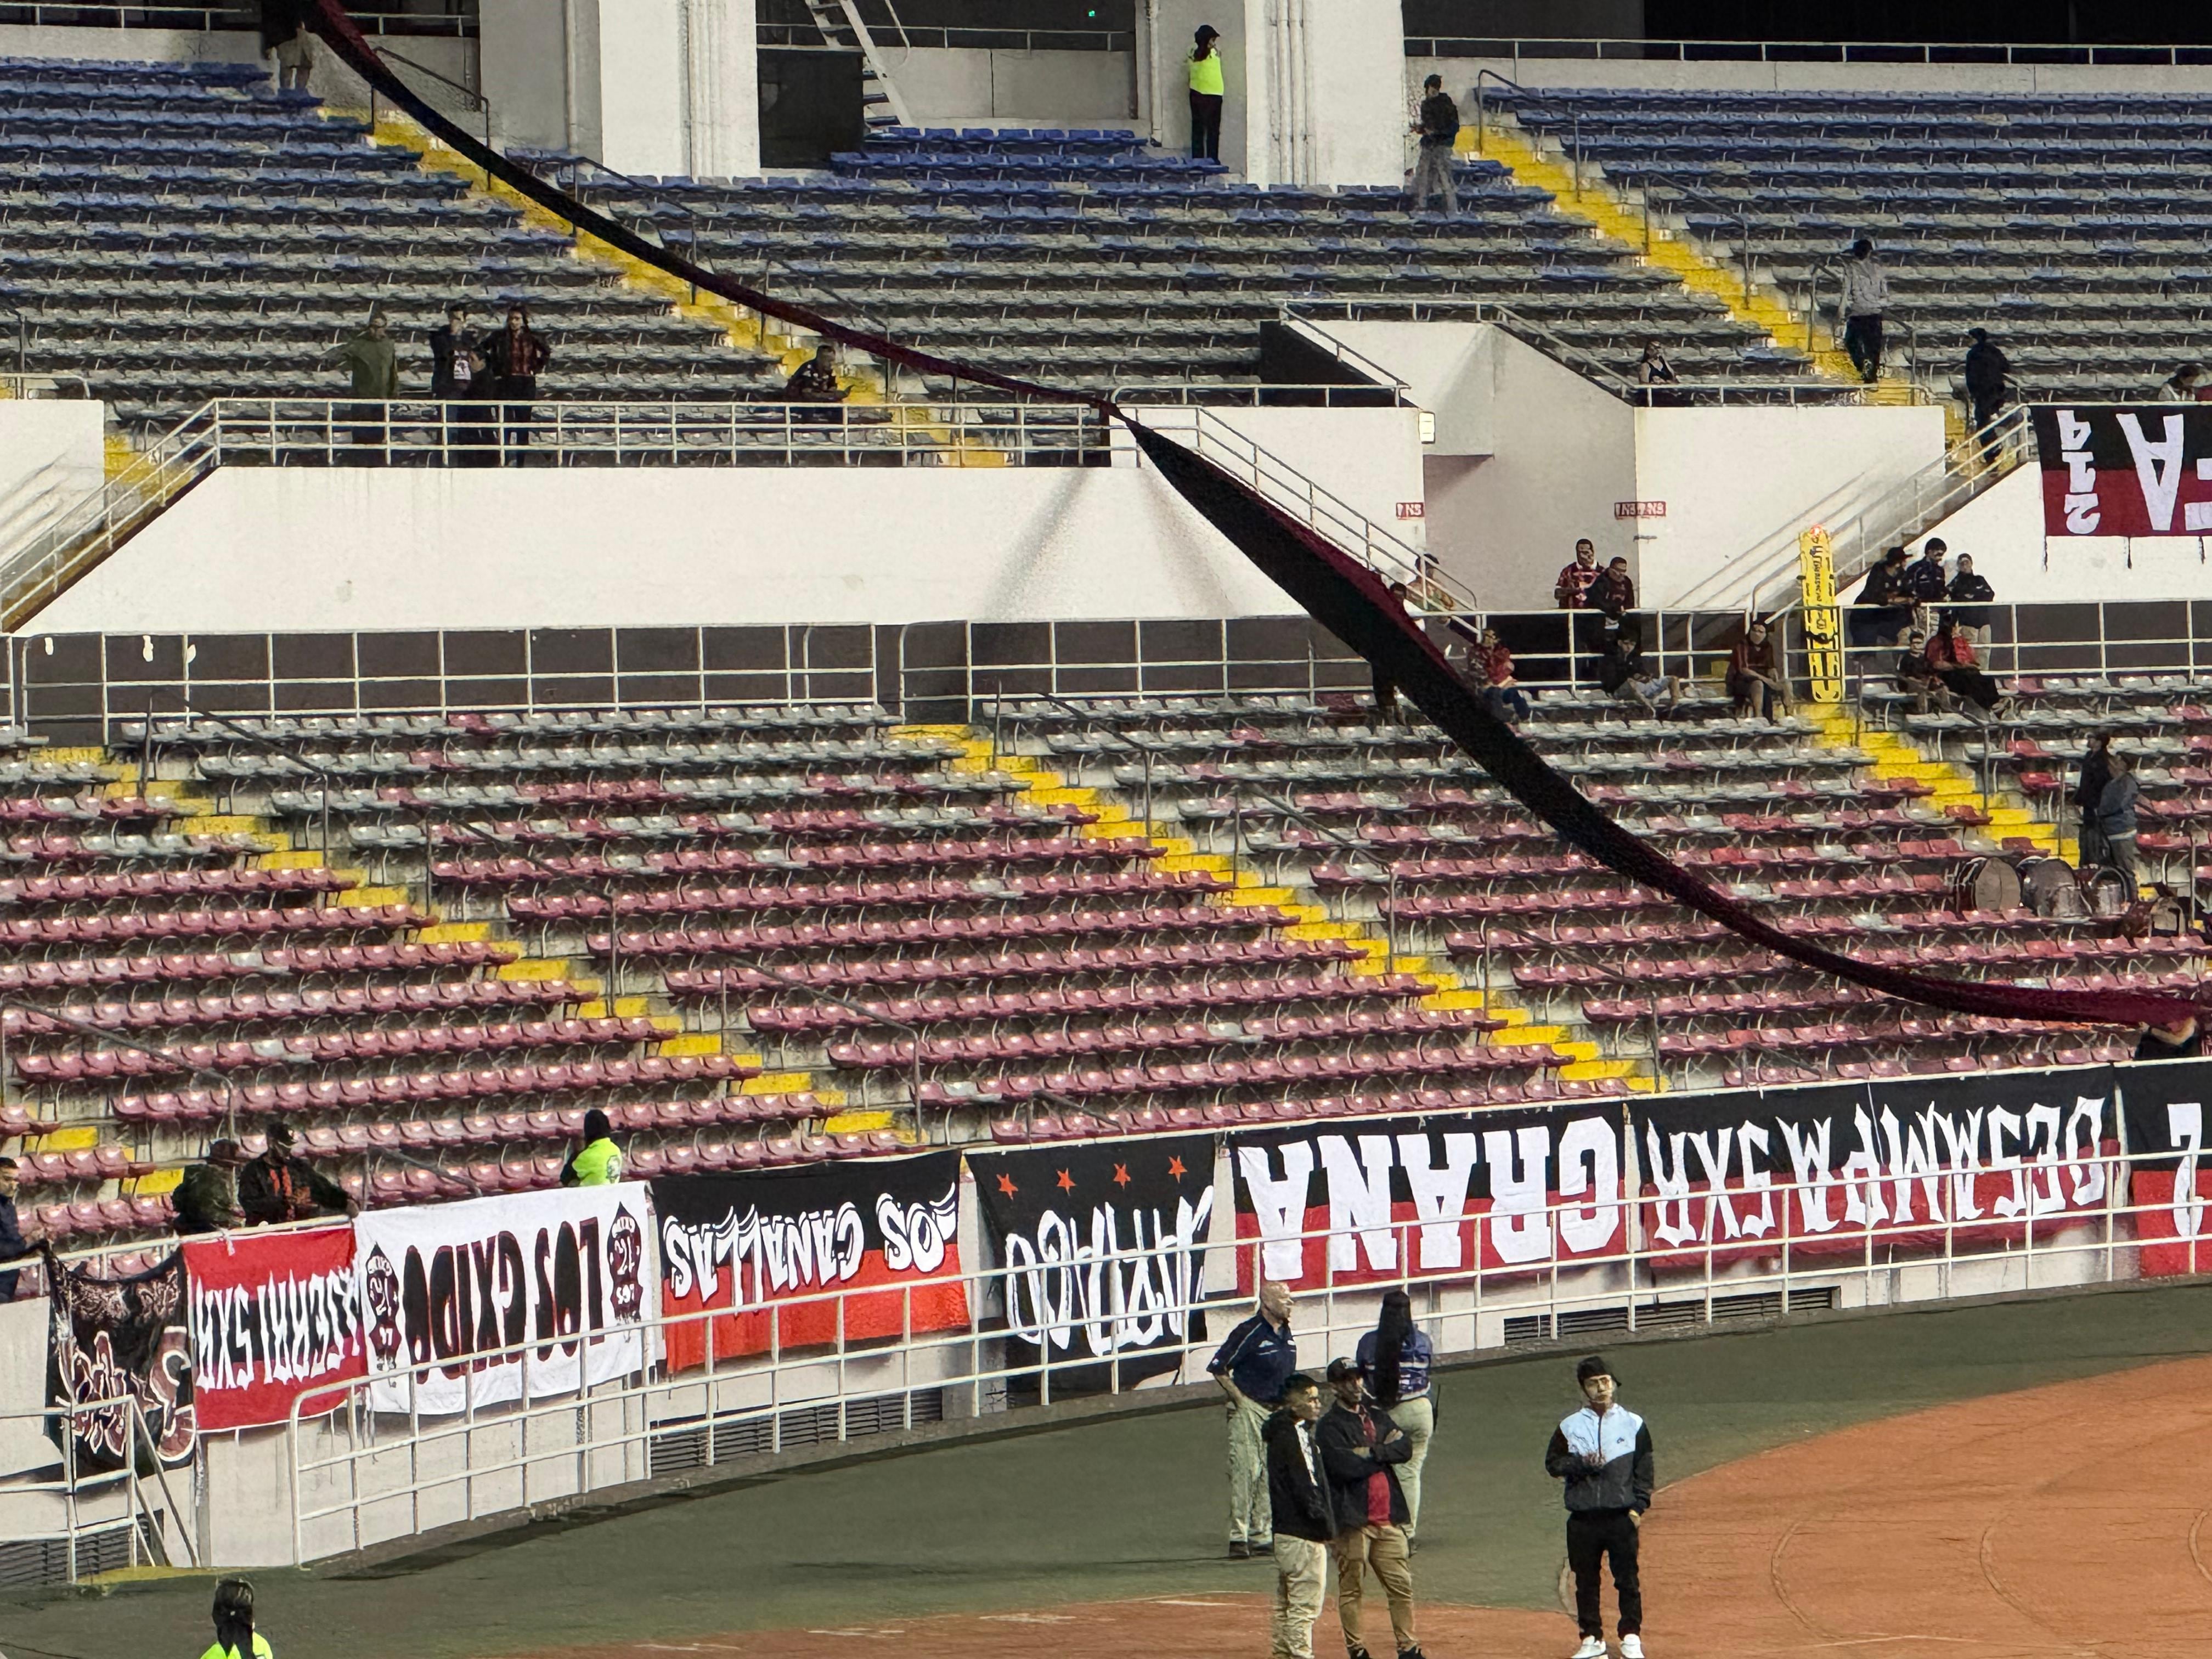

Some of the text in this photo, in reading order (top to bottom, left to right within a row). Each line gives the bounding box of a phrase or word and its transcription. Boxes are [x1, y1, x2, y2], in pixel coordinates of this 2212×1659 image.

[662, 1202, 865, 1316] CANALLAS
[1237, 1116, 1620, 1280] GRANA
[535, 1217, 605, 1363] LOS
